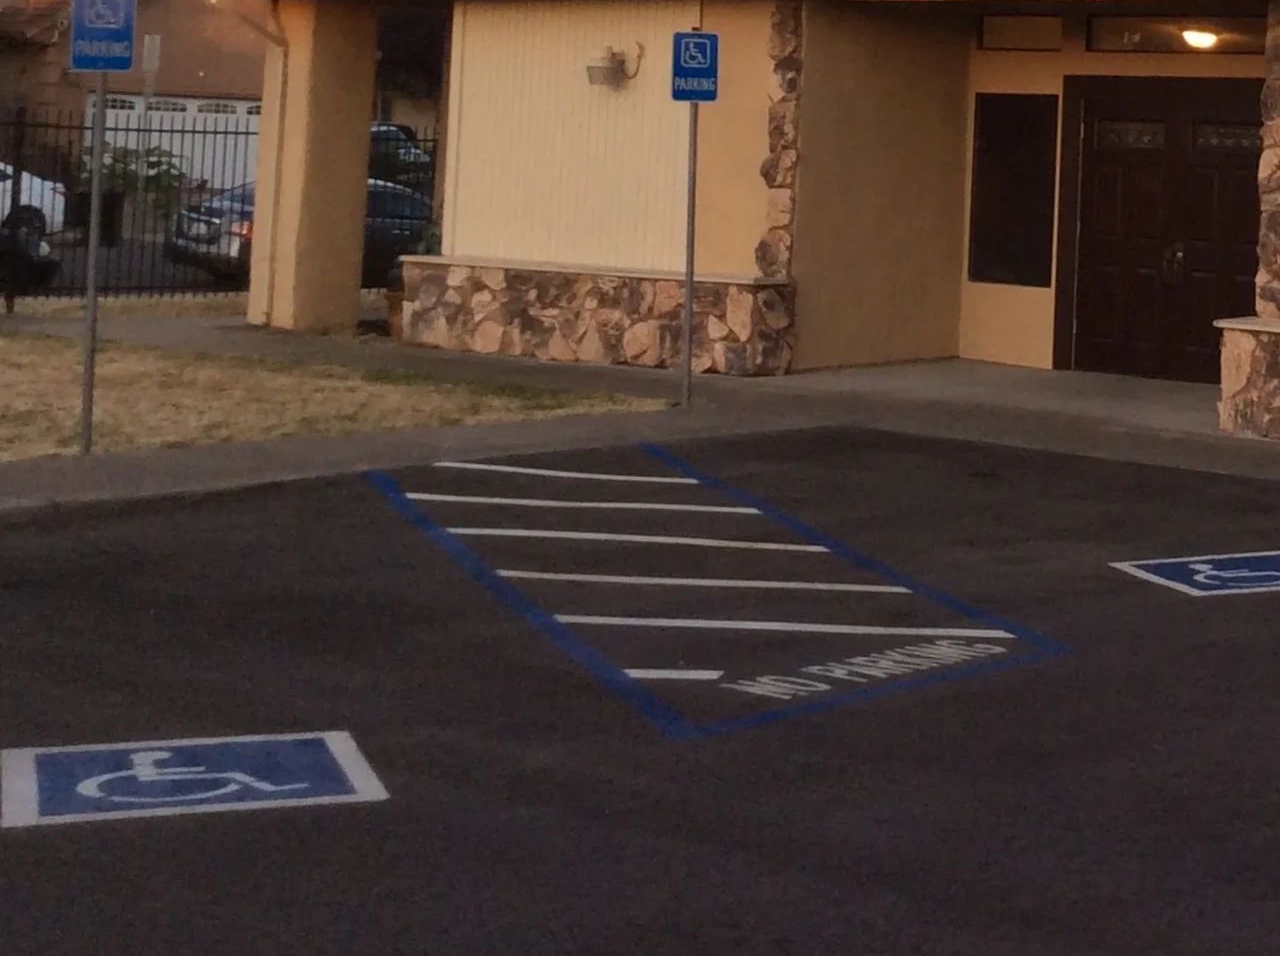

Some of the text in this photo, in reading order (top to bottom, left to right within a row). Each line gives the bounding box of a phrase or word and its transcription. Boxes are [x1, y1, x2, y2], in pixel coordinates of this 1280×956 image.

[75, 39, 130, 57] PARKING
[674, 76, 716, 91] PARKING
[720, 639, 1008, 699] NO PARKING
